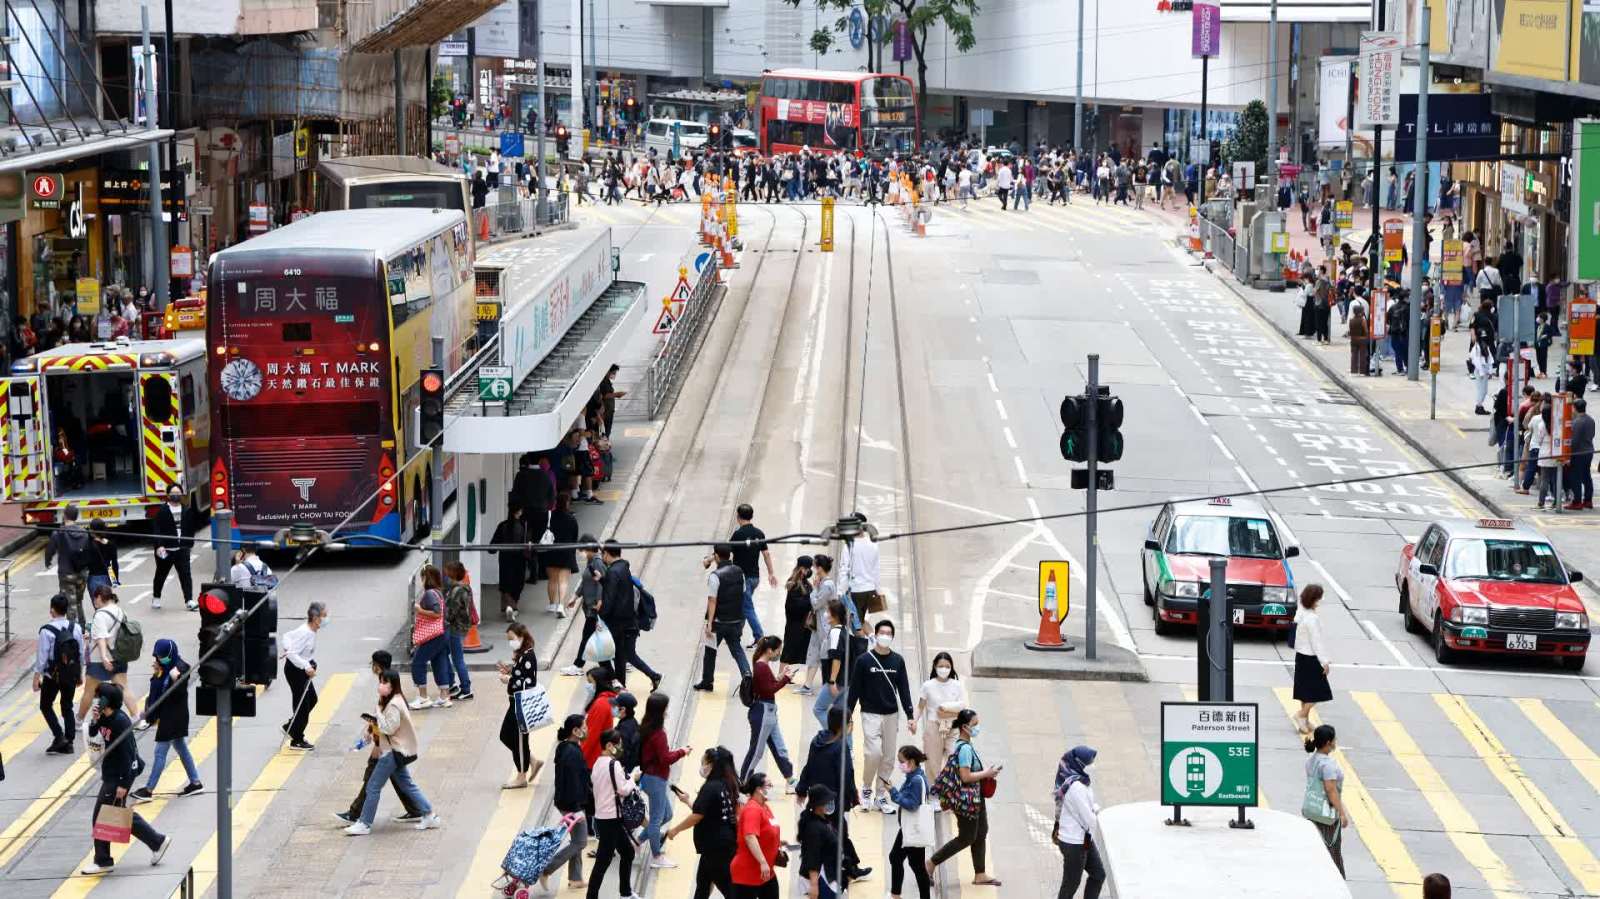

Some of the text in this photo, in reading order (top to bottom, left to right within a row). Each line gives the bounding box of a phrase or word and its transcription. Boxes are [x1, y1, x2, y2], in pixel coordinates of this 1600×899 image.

[1372, 53, 1383, 121] HONG KONG
[1405, 123, 1443, 133] TL
[283, 268, 301, 276] 6410
[254, 287, 339, 312] 周大福
[266, 362, 380, 375] 周大福 T MARK
[1315, 479, 1449, 498] STOP
[1346, 500, 1463, 519] BUS
[256, 512, 290, 521] Exclusively
[1480, 519, 1513, 529] TAXI
[1509, 641, 1534, 650] 6703
[1199, 710, 1250, 723] 百德新街
[1192, 724, 1250, 732] Paterson Street
[1228, 747, 1250, 757] 53E
